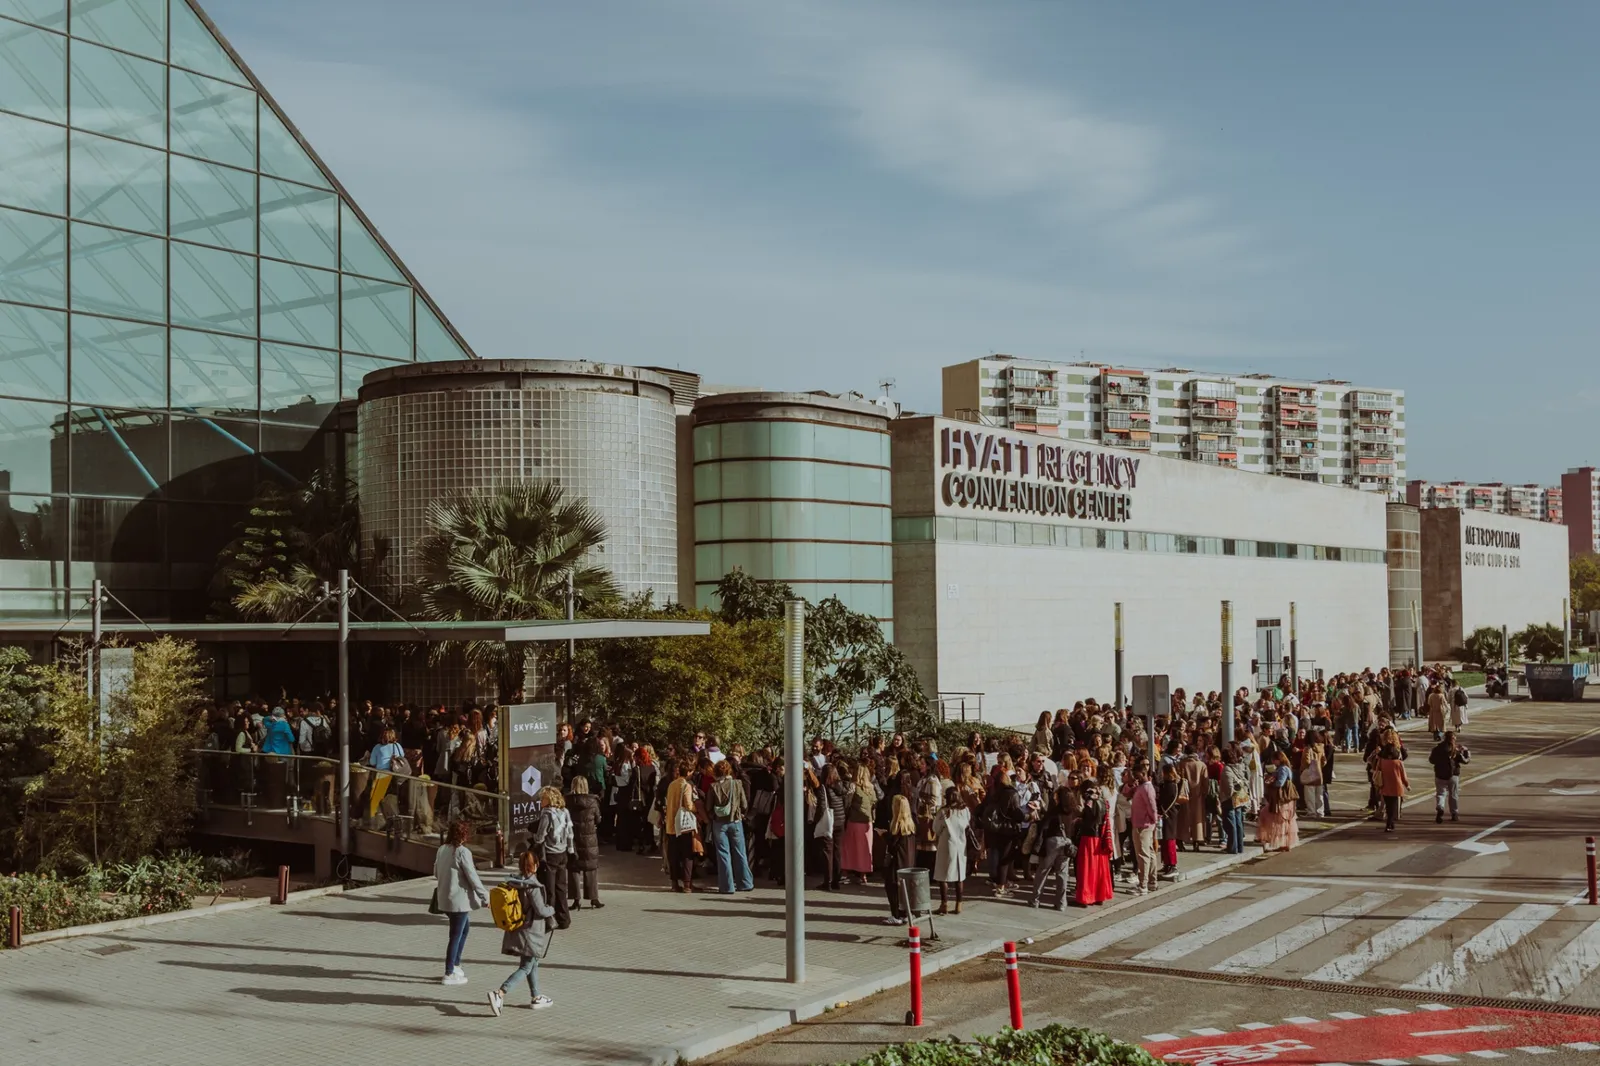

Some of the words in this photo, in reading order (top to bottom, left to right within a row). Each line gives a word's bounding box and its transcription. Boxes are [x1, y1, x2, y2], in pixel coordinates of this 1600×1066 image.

[941, 427, 1034, 478] HYATT
[1037, 443, 1140, 490] REGENCY
[942, 471, 1068, 515] CONVENTION
[1068, 487, 1134, 522] CENTER
[1465, 525, 1520, 549] METROPOLITAN
[513, 722, 549, 732] SKYFALL
[513, 800, 542, 815] HYAT
[513, 814, 540, 825] REGEN
